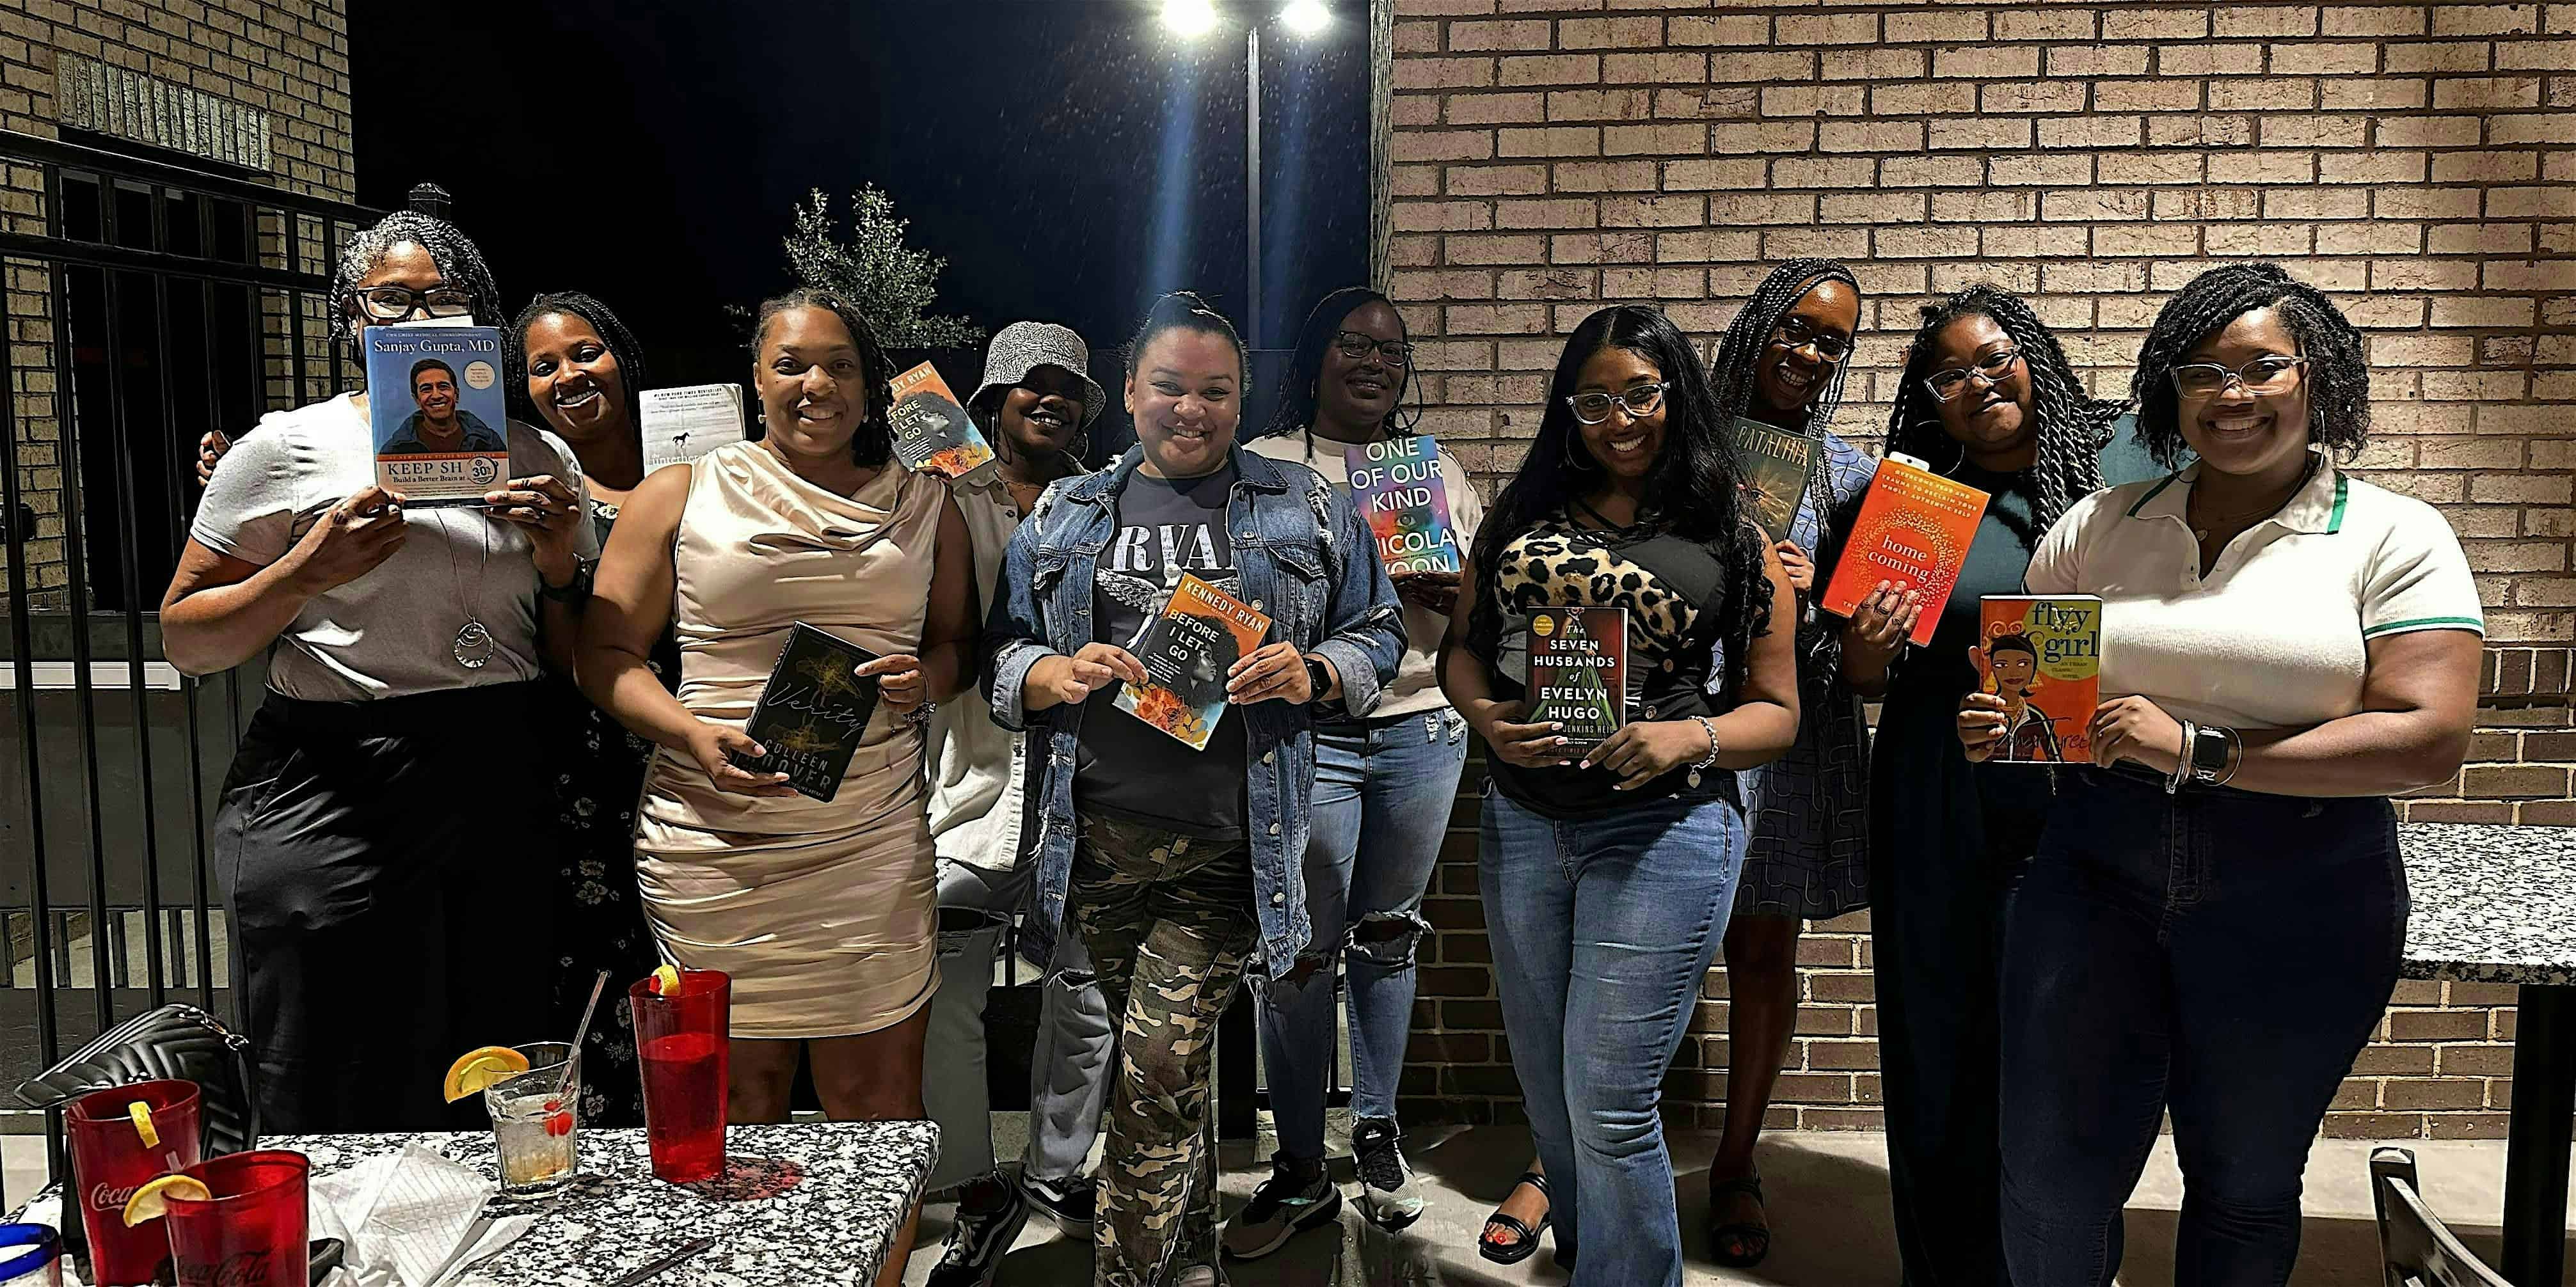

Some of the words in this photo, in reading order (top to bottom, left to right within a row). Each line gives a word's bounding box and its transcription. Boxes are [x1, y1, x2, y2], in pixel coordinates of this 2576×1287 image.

[374, 340, 416, 354] Sanjay
[420, 340, 465, 354] Gupta,
[468, 340, 495, 352] MD
[907, 366, 932, 385] RYAN
[890, 399, 921, 420] FORE
[898, 413, 922, 430] LET
[905, 427, 922, 440] GO
[1365, 437, 1420, 461] ONE
[387, 462, 433, 475] KEEP
[1351, 467, 1385, 489] OF
[1390, 459, 1443, 484] OUR
[1371, 487, 1432, 512] KIND
[1882, 474, 1910, 487] TRAUMA
[1924, 489, 1955, 503] RECLAIM
[1911, 494, 1952, 511] AUTHENTIC
[1110, 523, 1237, 571] RVA
[1882, 535, 1928, 562] home
[1868, 551, 1930, 583] coming
[1184, 580, 1236, 615] KENNEDY
[1235, 609, 1265, 633] RYAN
[2032, 601, 2092, 635] flyy
[1168, 609, 1220, 643] BEFORE
[1566, 625, 1585, 634] The
[1169, 626, 1176, 636] I
[1177, 632, 1204, 651] LET
[1550, 640, 1599, 651] SEVEN
[2044, 631, 2099, 663] girl
[1169, 644, 1188, 661] GO
[1534, 656, 1615, 667] HUSBANDS
[1569, 672, 1581, 682] of
[1541, 687, 1607, 700] EVELYN
[767, 682, 867, 739] Verity
[1548, 706, 1600, 720] HUGO
[764, 739, 828, 771] COLLEEN
[761, 754, 831, 789] OOVER
